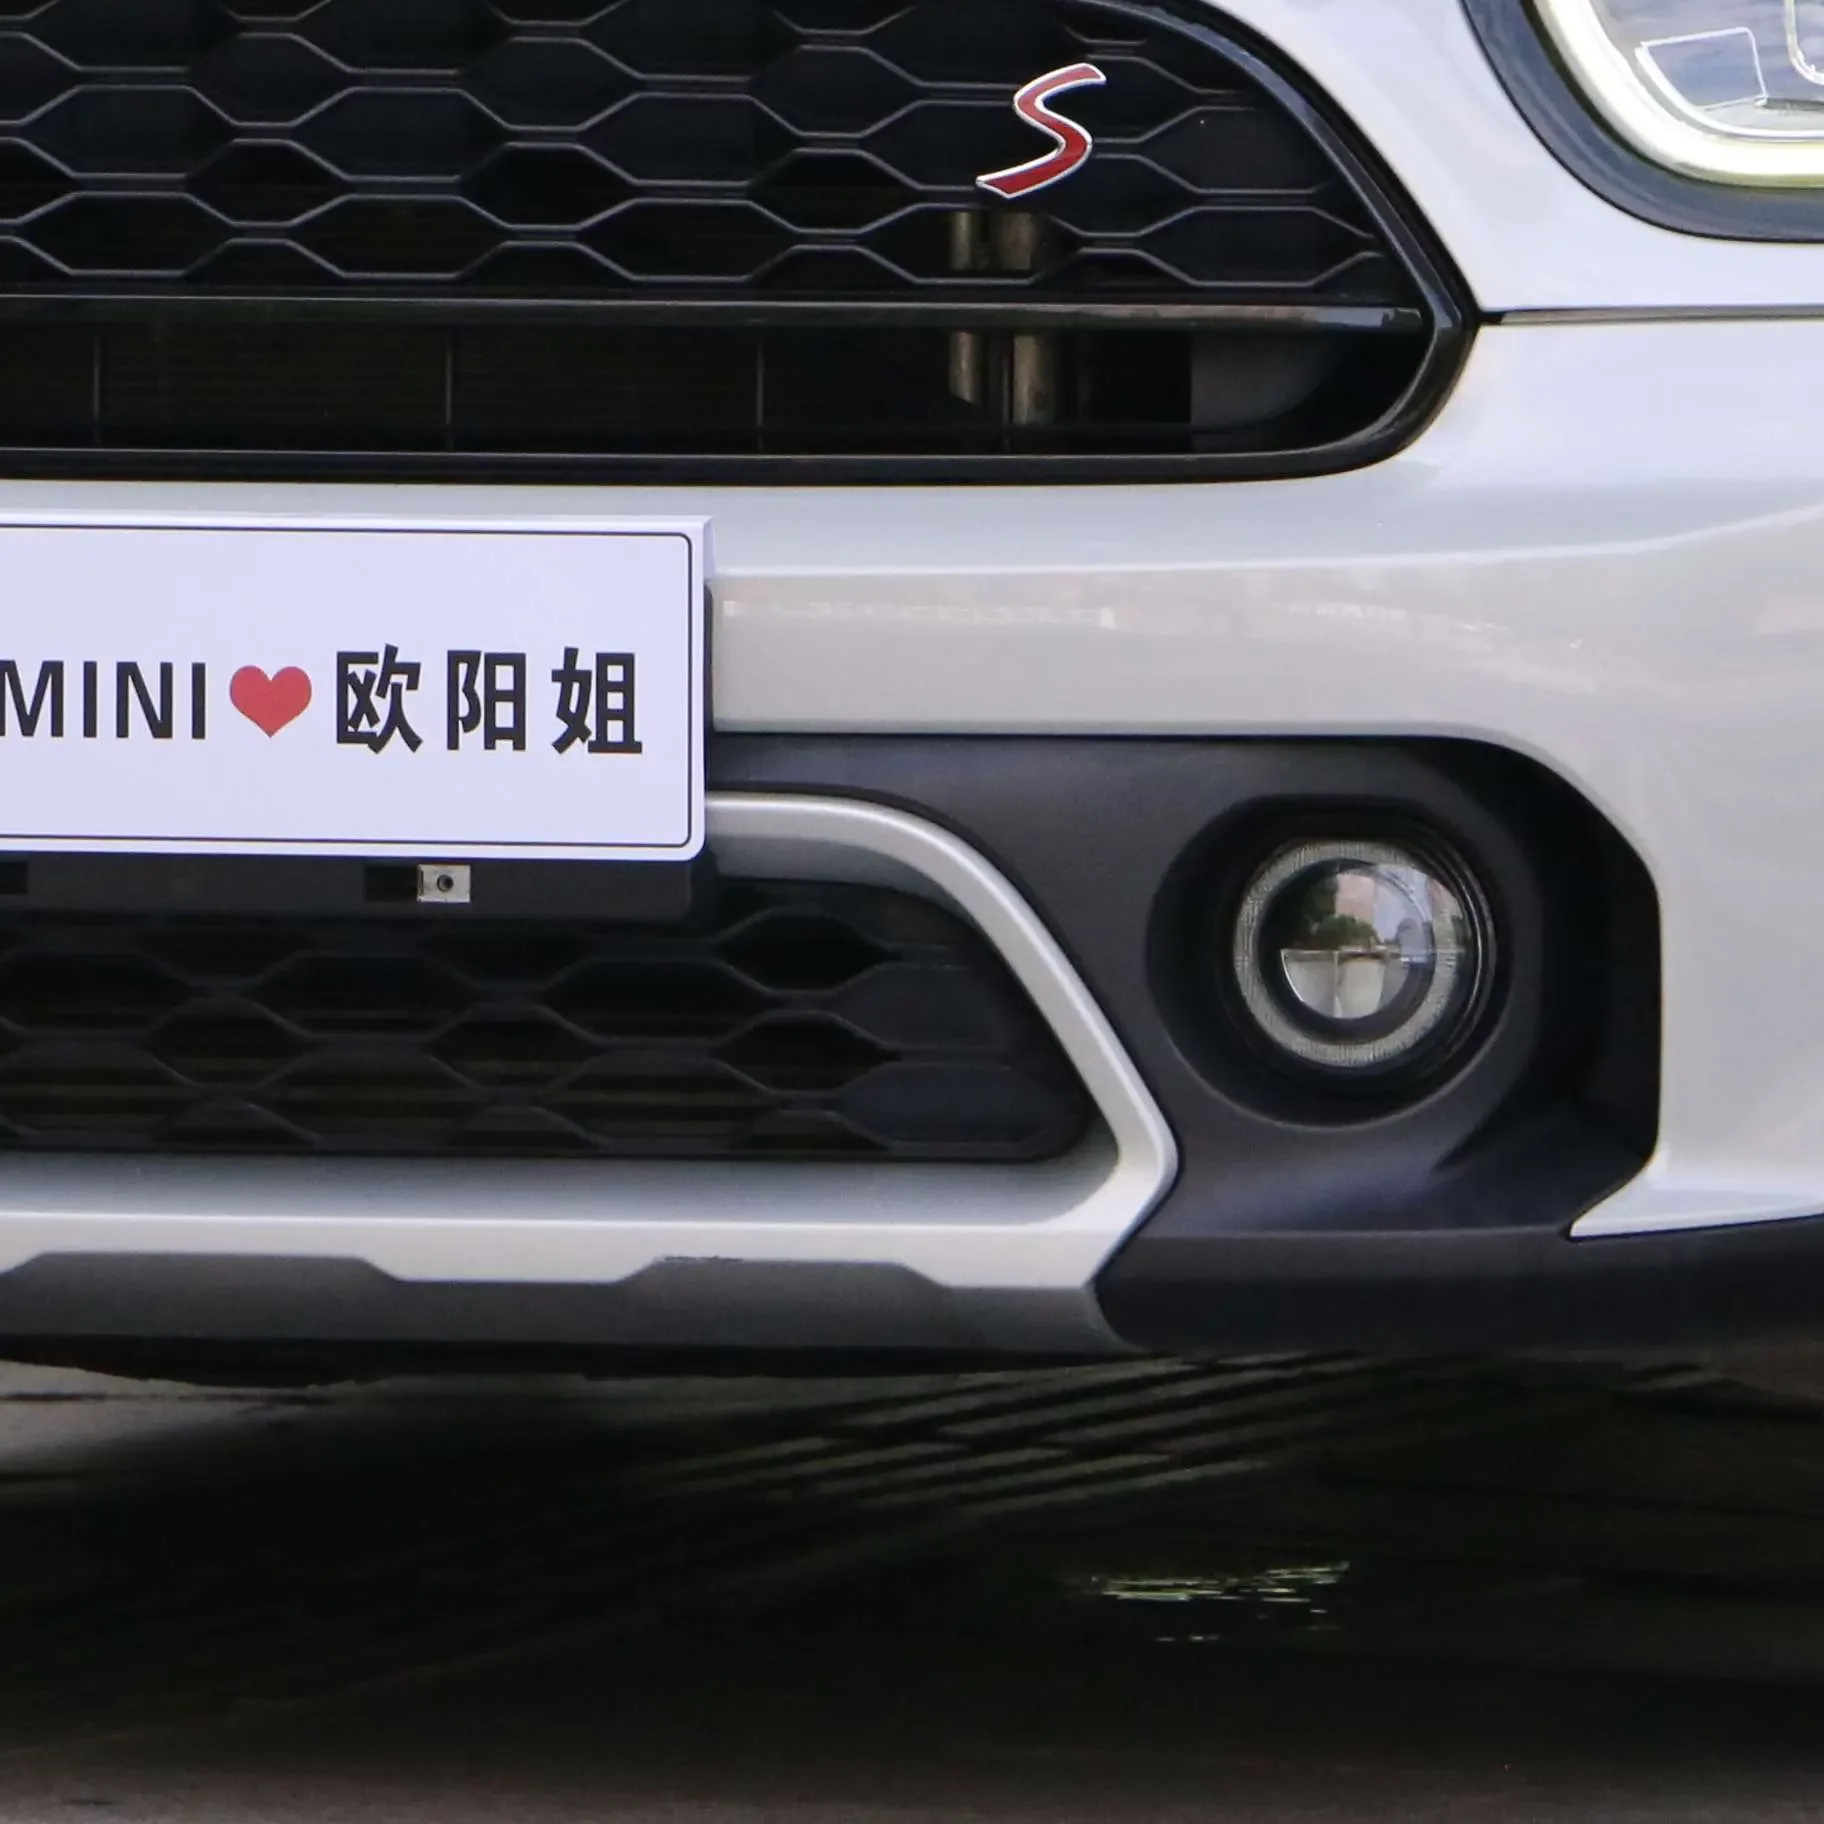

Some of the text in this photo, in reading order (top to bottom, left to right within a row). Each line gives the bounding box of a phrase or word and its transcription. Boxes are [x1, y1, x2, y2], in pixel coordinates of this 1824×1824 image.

[975, 62, 1107, 199] S
[335, 643, 644, 755] 欧阳姐
